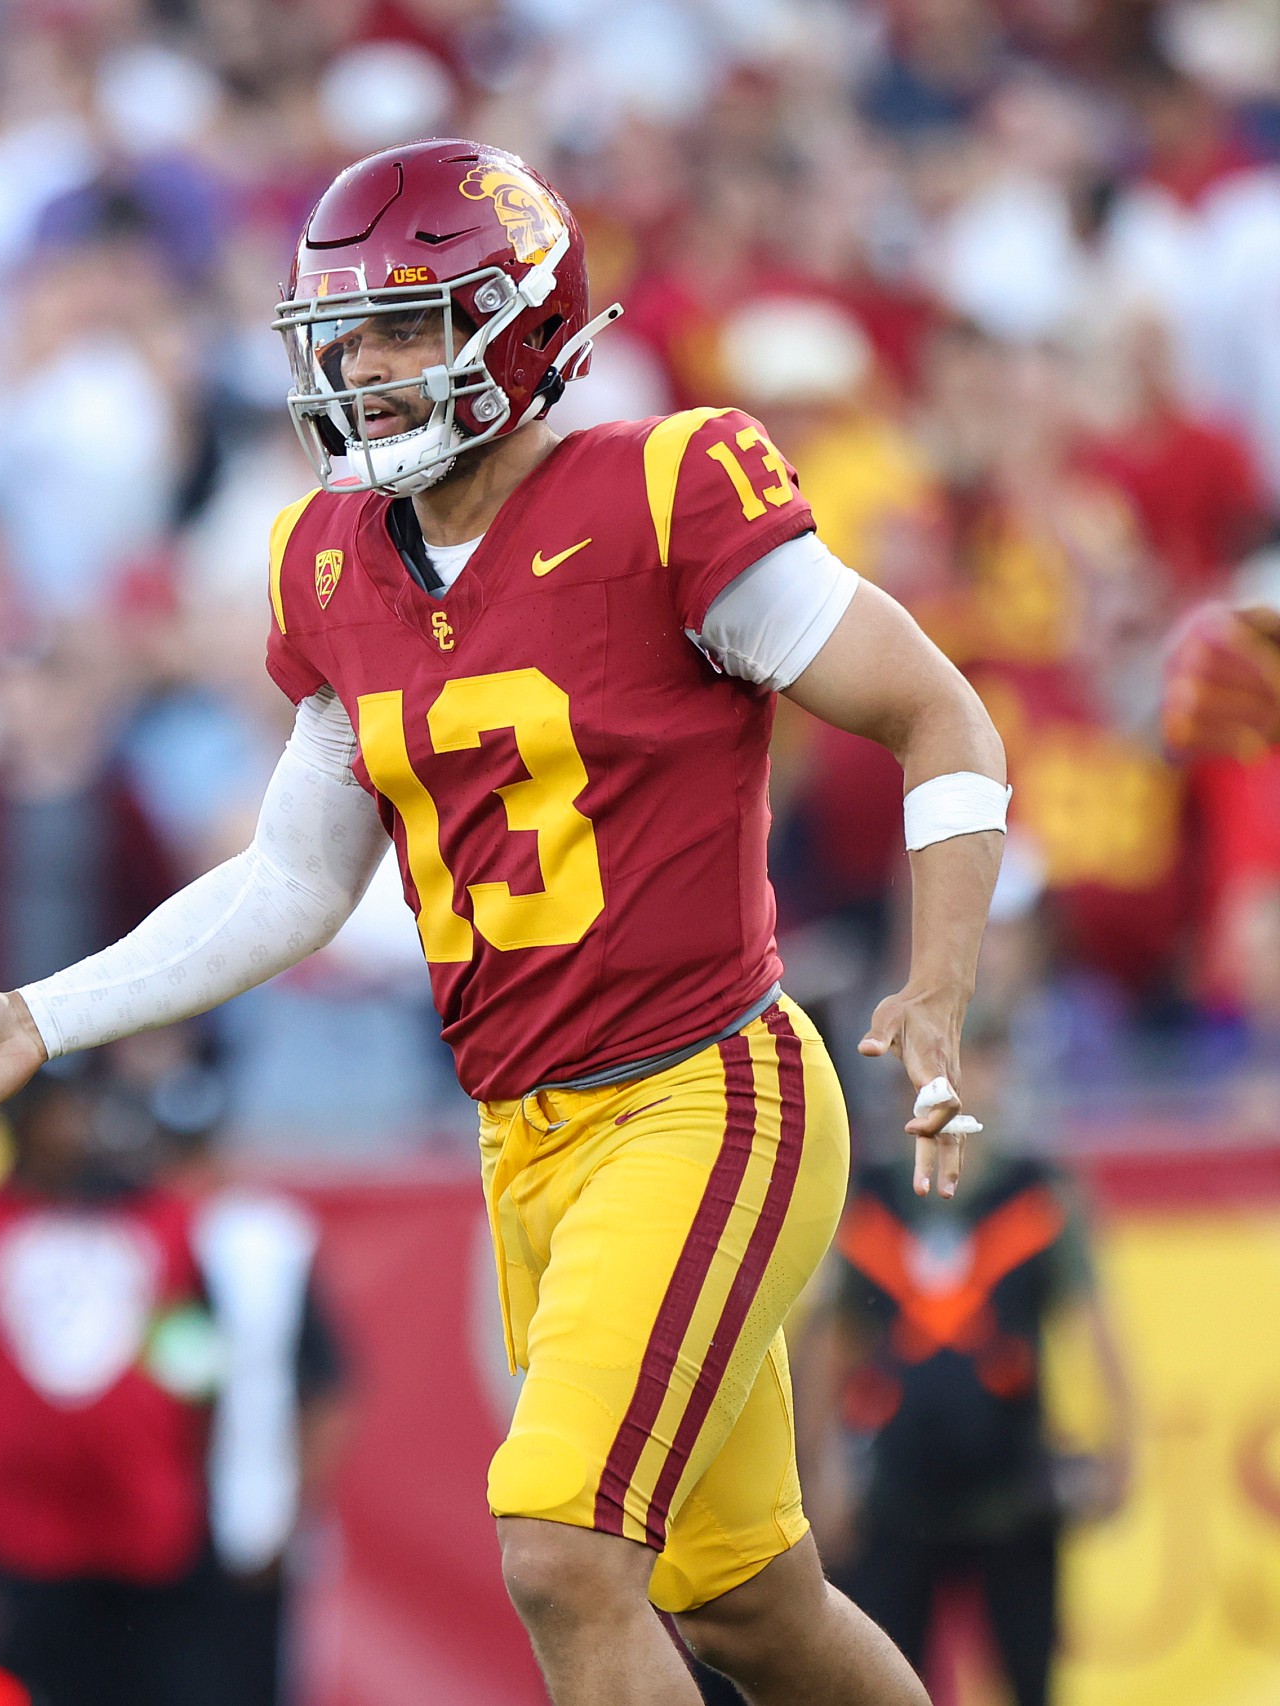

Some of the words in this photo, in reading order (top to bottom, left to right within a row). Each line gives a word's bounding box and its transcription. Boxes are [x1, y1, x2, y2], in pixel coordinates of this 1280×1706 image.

[393, 266, 428, 284] USC
[705, 425, 793, 521] 13
[316, 550, 343, 585] PAC
[431, 611, 455, 650] SC
[356, 666, 605, 964] 13
